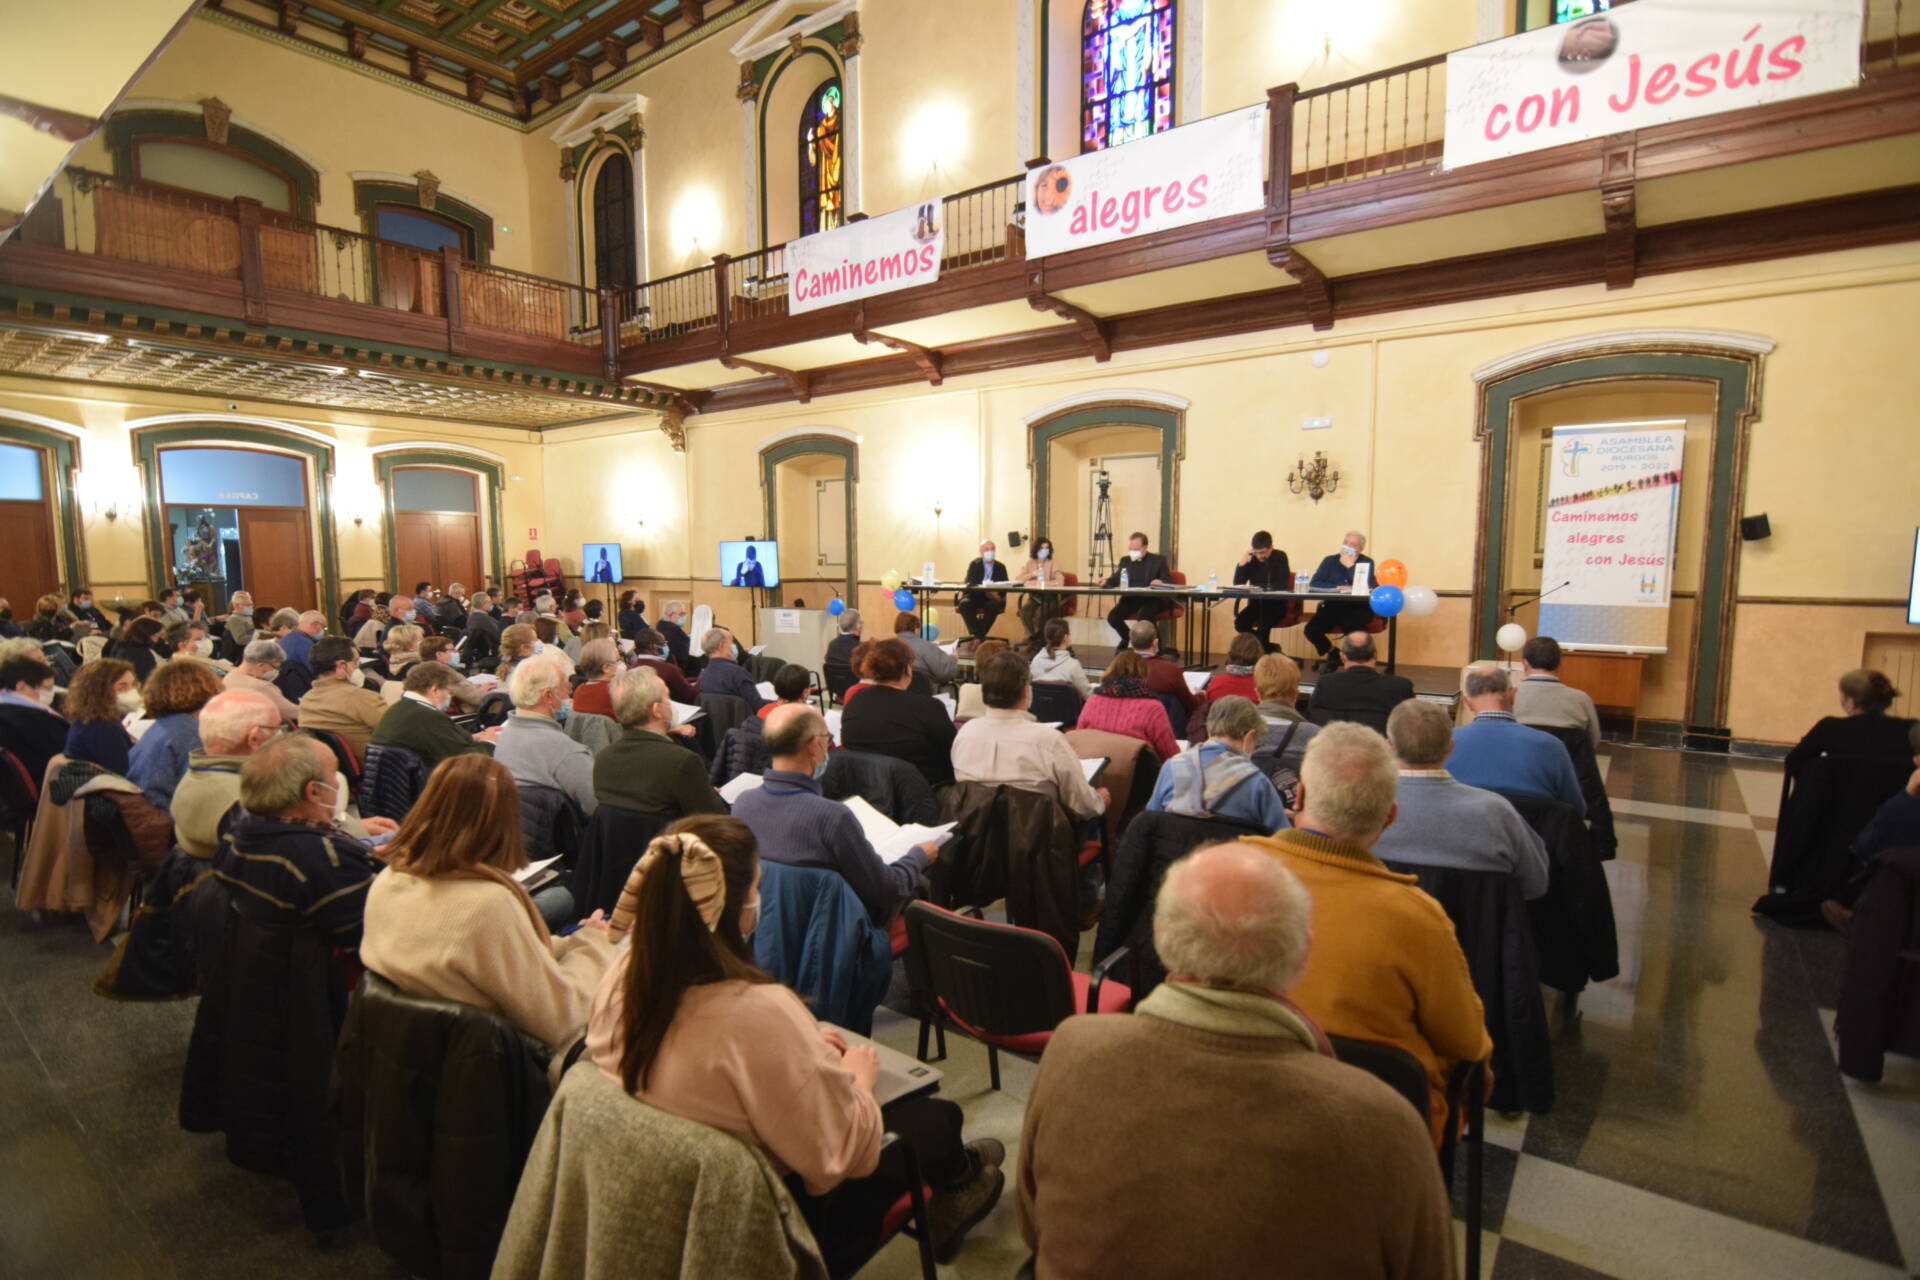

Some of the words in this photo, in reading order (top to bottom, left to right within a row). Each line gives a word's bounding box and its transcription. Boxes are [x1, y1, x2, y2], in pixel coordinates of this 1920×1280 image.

[1484, 84, 1580, 141] con
[1608, 24, 1806, 113] Jesús
[1069, 173, 1209, 236] alegres
[794, 243, 935, 302] Caminemos
[1600, 435, 1673, 446] ASAMBLEA
[1596, 444, 1675, 455] DIOCESANA
[1641, 462, 1670, 470] 2022
[1551, 511, 1639, 523] Caminemos
[1567, 532, 1625, 546] alegres
[1585, 555, 1612, 566] con
[1618, 553, 1665, 567] Jesús
